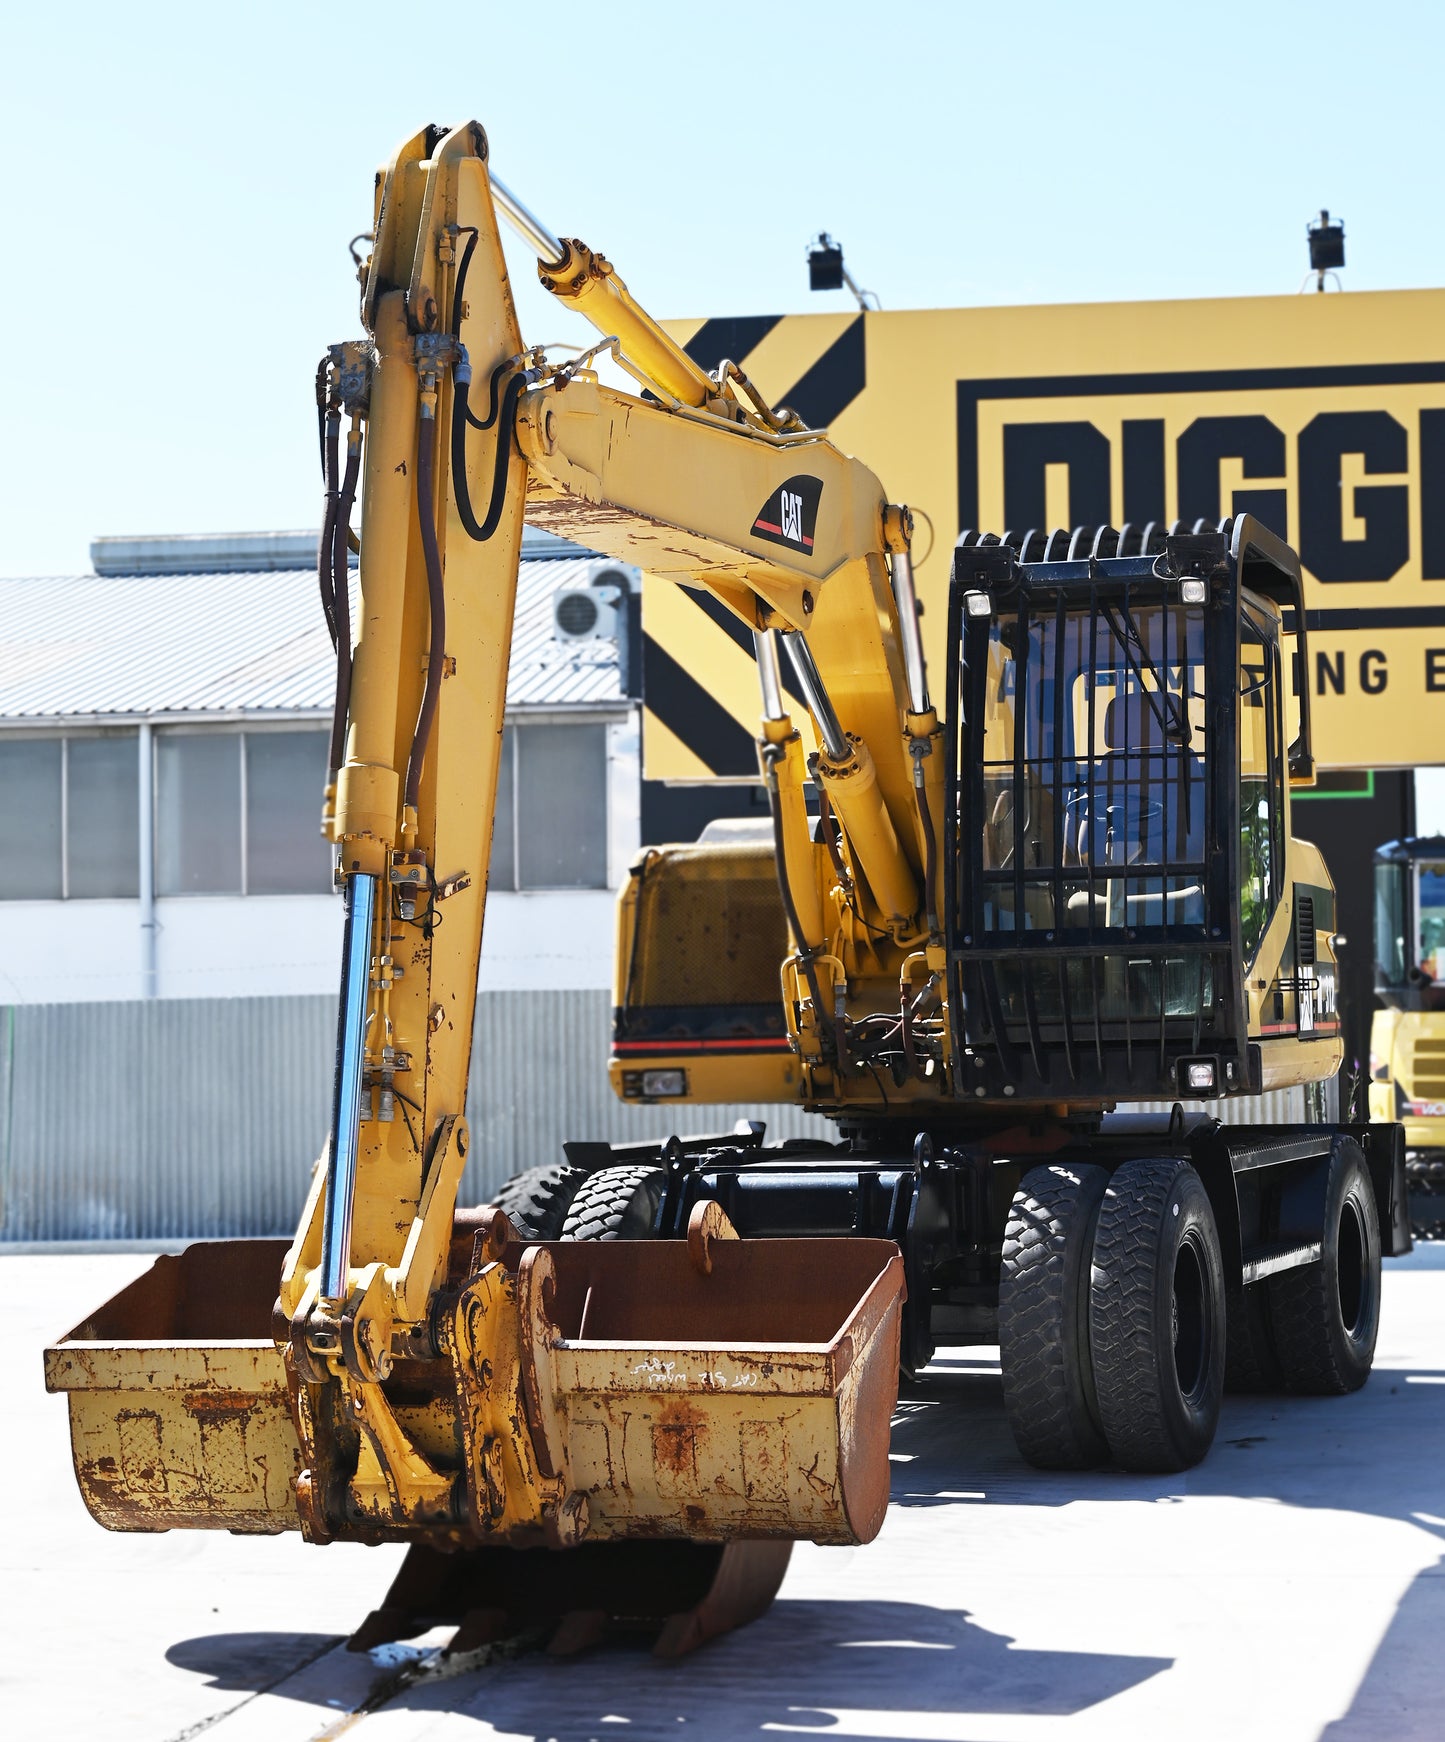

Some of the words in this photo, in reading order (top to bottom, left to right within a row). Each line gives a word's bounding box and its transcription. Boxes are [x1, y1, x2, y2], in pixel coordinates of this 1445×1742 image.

[781, 489, 803, 543] CAT
[1003, 408, 1445, 583] DIGG
[731, 1373, 757, 1387] CAT
